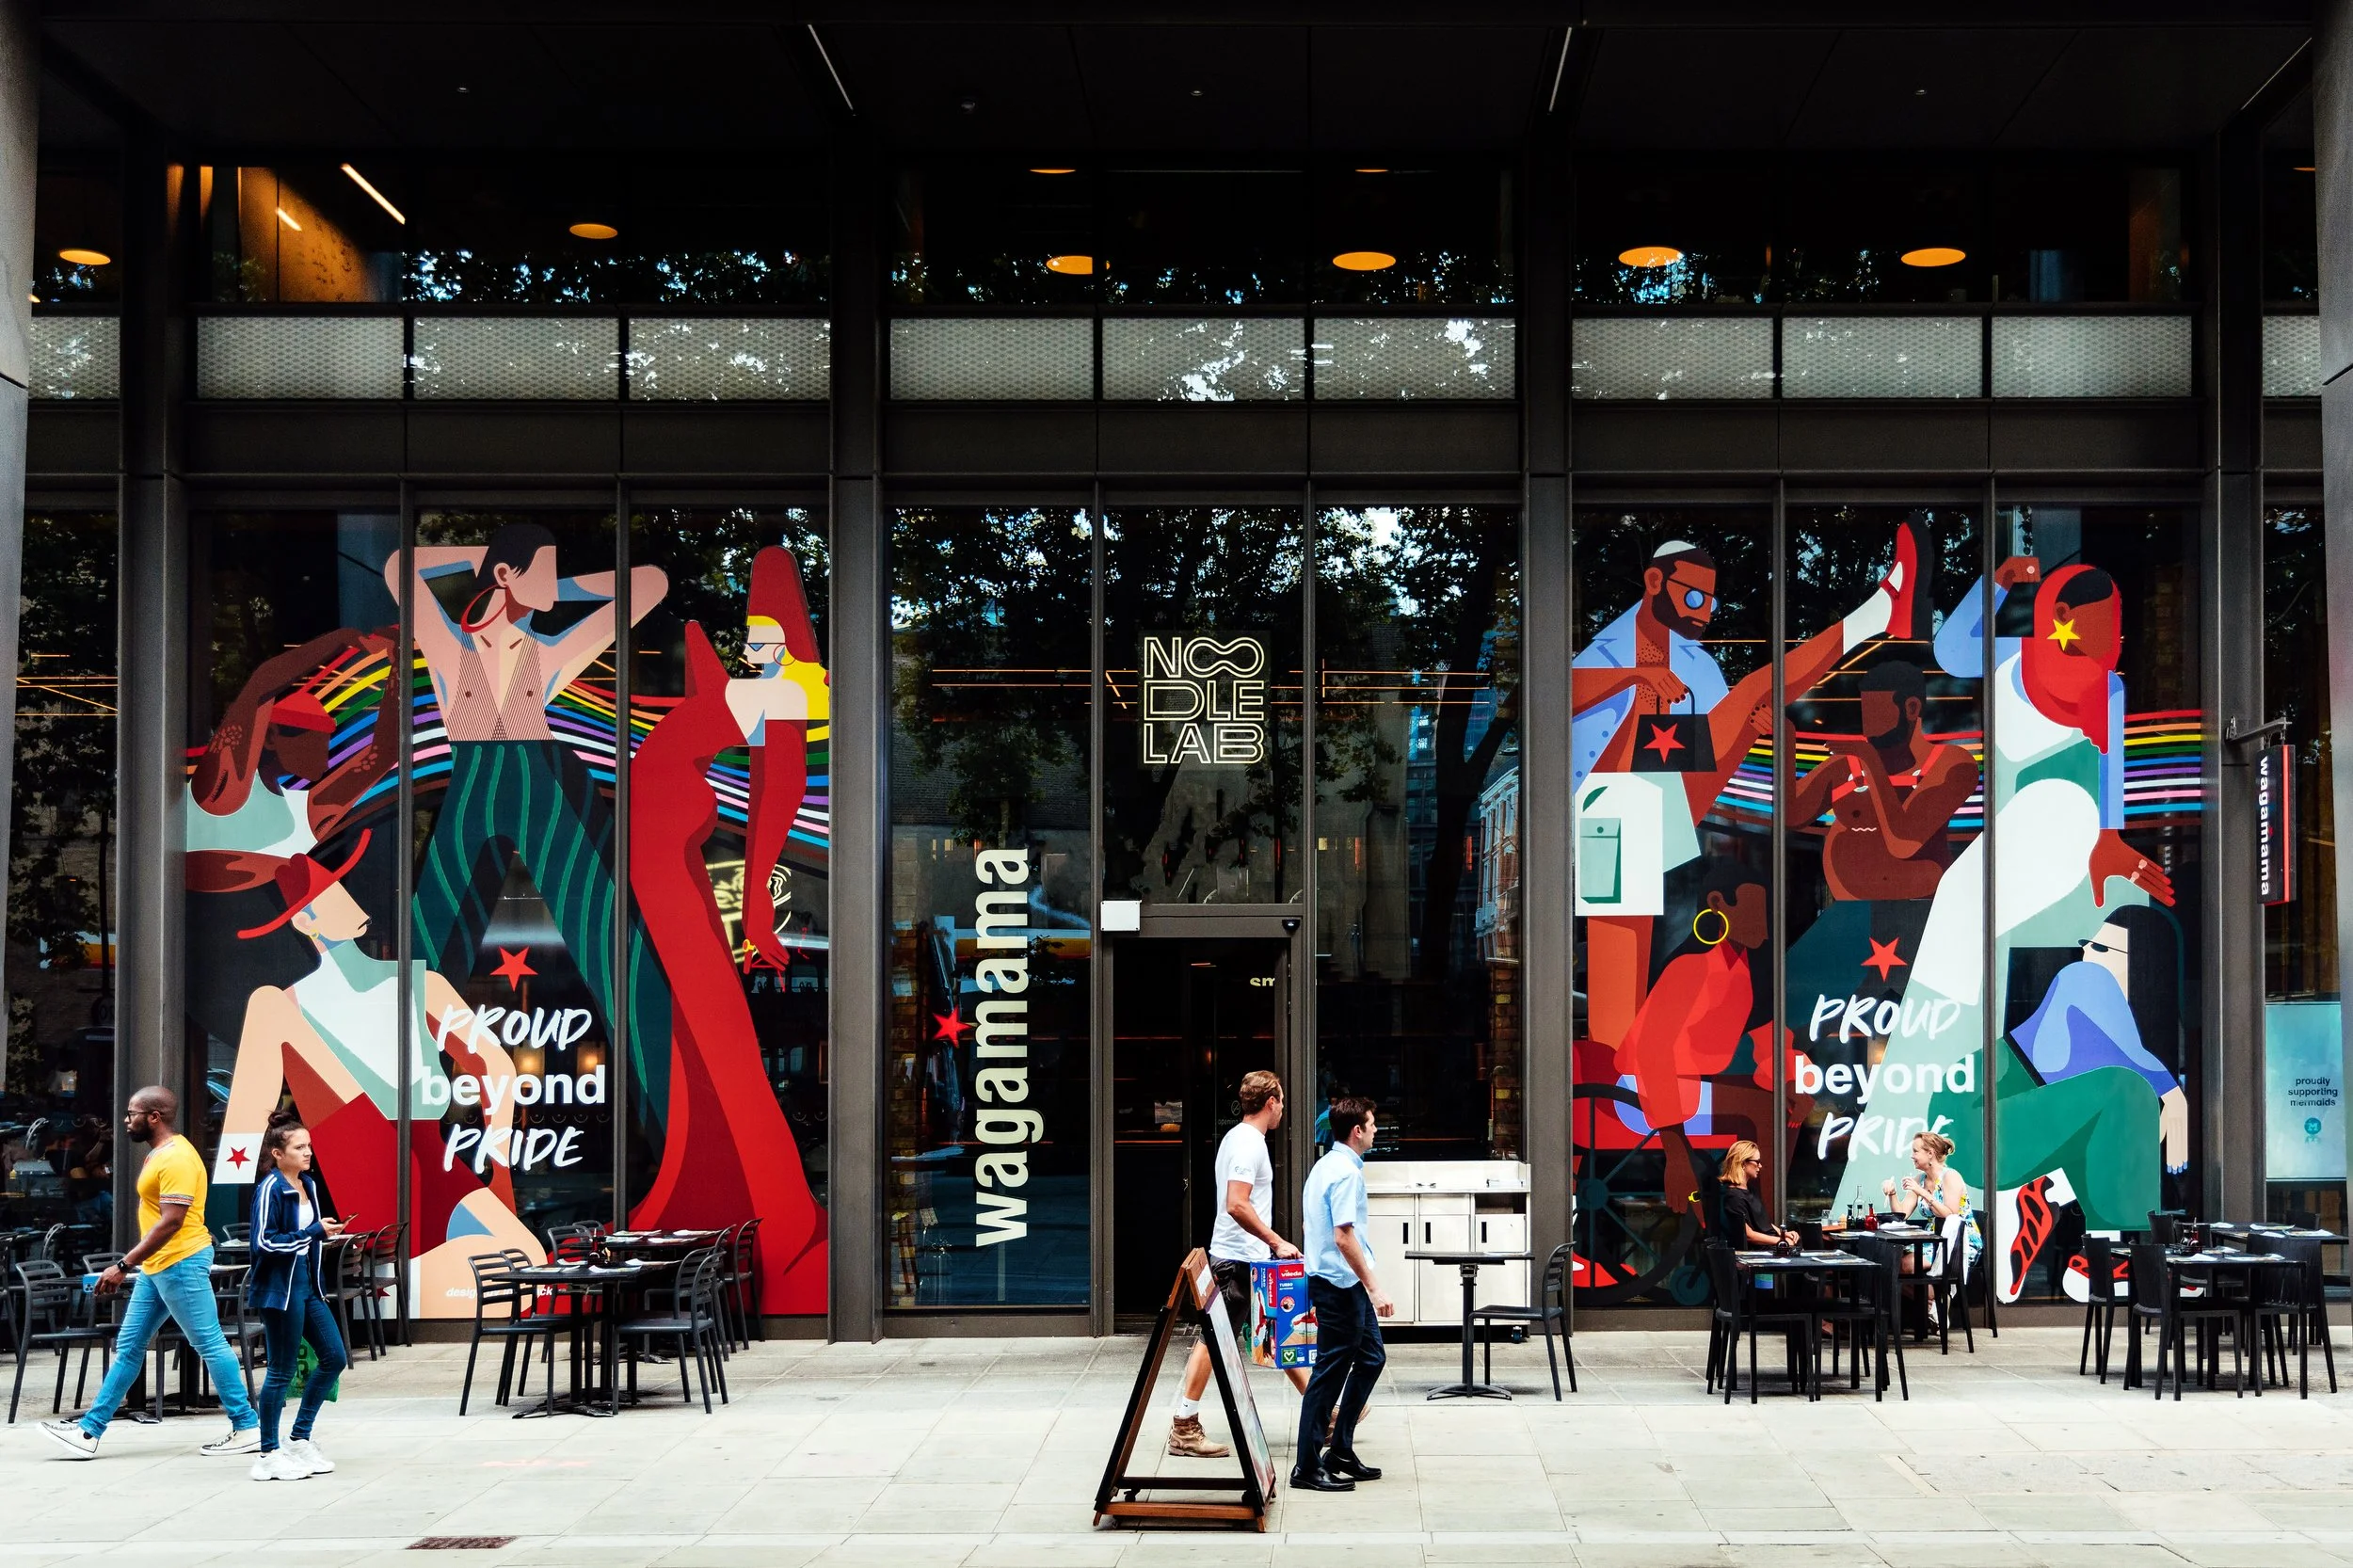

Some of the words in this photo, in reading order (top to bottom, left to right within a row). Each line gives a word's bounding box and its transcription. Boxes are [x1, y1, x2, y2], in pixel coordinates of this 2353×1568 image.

[1144, 680, 1265, 721] DLE
[1144, 723, 1265, 764] LAB
[2259, 755, 2269, 896] wagamama
[437, 1003, 593, 1054] PROUD
[1809, 994, 1961, 1044] PROUD
[975, 848, 1044, 1247] wagamama
[421, 1064, 606, 1116] beyond
[1795, 1054, 1975, 1105] beyond
[2288, 1087, 2338, 1097] supporting
[2290, 1097, 2336, 1107] mermaids
[2296, 1077, 2330, 1086] proudly
[442, 1123, 584, 1175] PRIDE
[445, 1287, 479, 1299] desig
